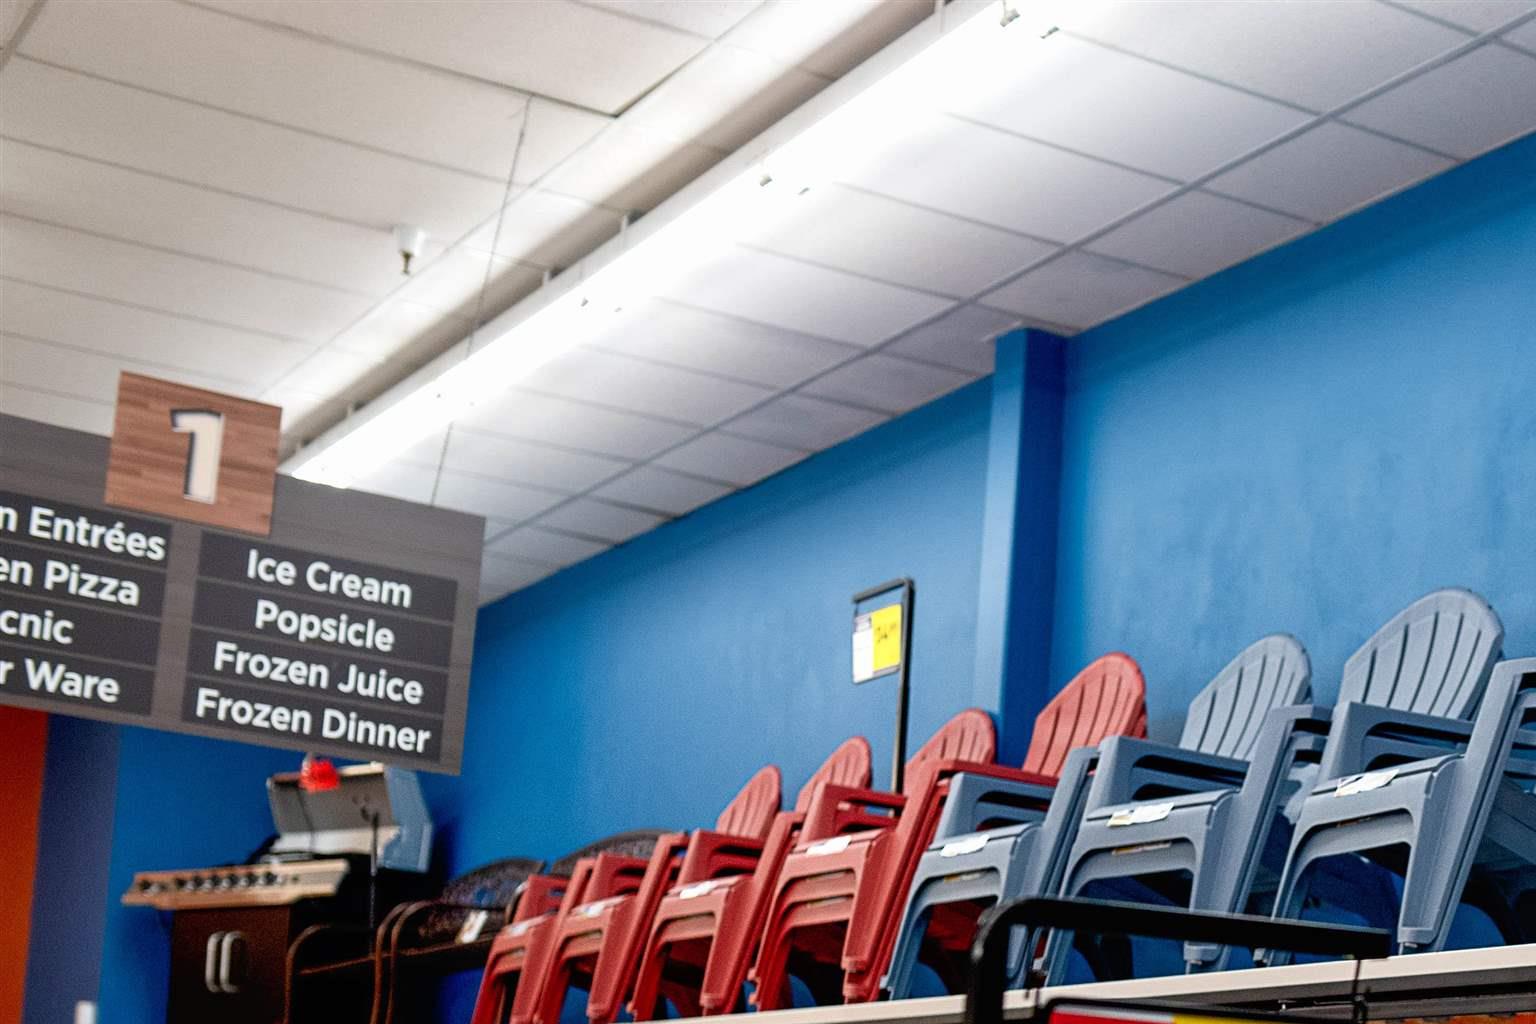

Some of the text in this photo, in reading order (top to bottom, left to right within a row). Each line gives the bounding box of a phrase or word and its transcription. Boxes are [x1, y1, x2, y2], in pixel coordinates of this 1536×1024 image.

[170, 407, 224, 504] 1
[29, 506, 167, 561] Entrées
[44, 559, 140, 606] Pizza
[247, 549, 412, 607] Ice Cream
[255, 600, 396, 652] Popsicle
[25, 658, 120, 703] Ware
[214, 641, 424, 704] Frozen Juice
[196, 687, 431, 752] Frozen Dinner
